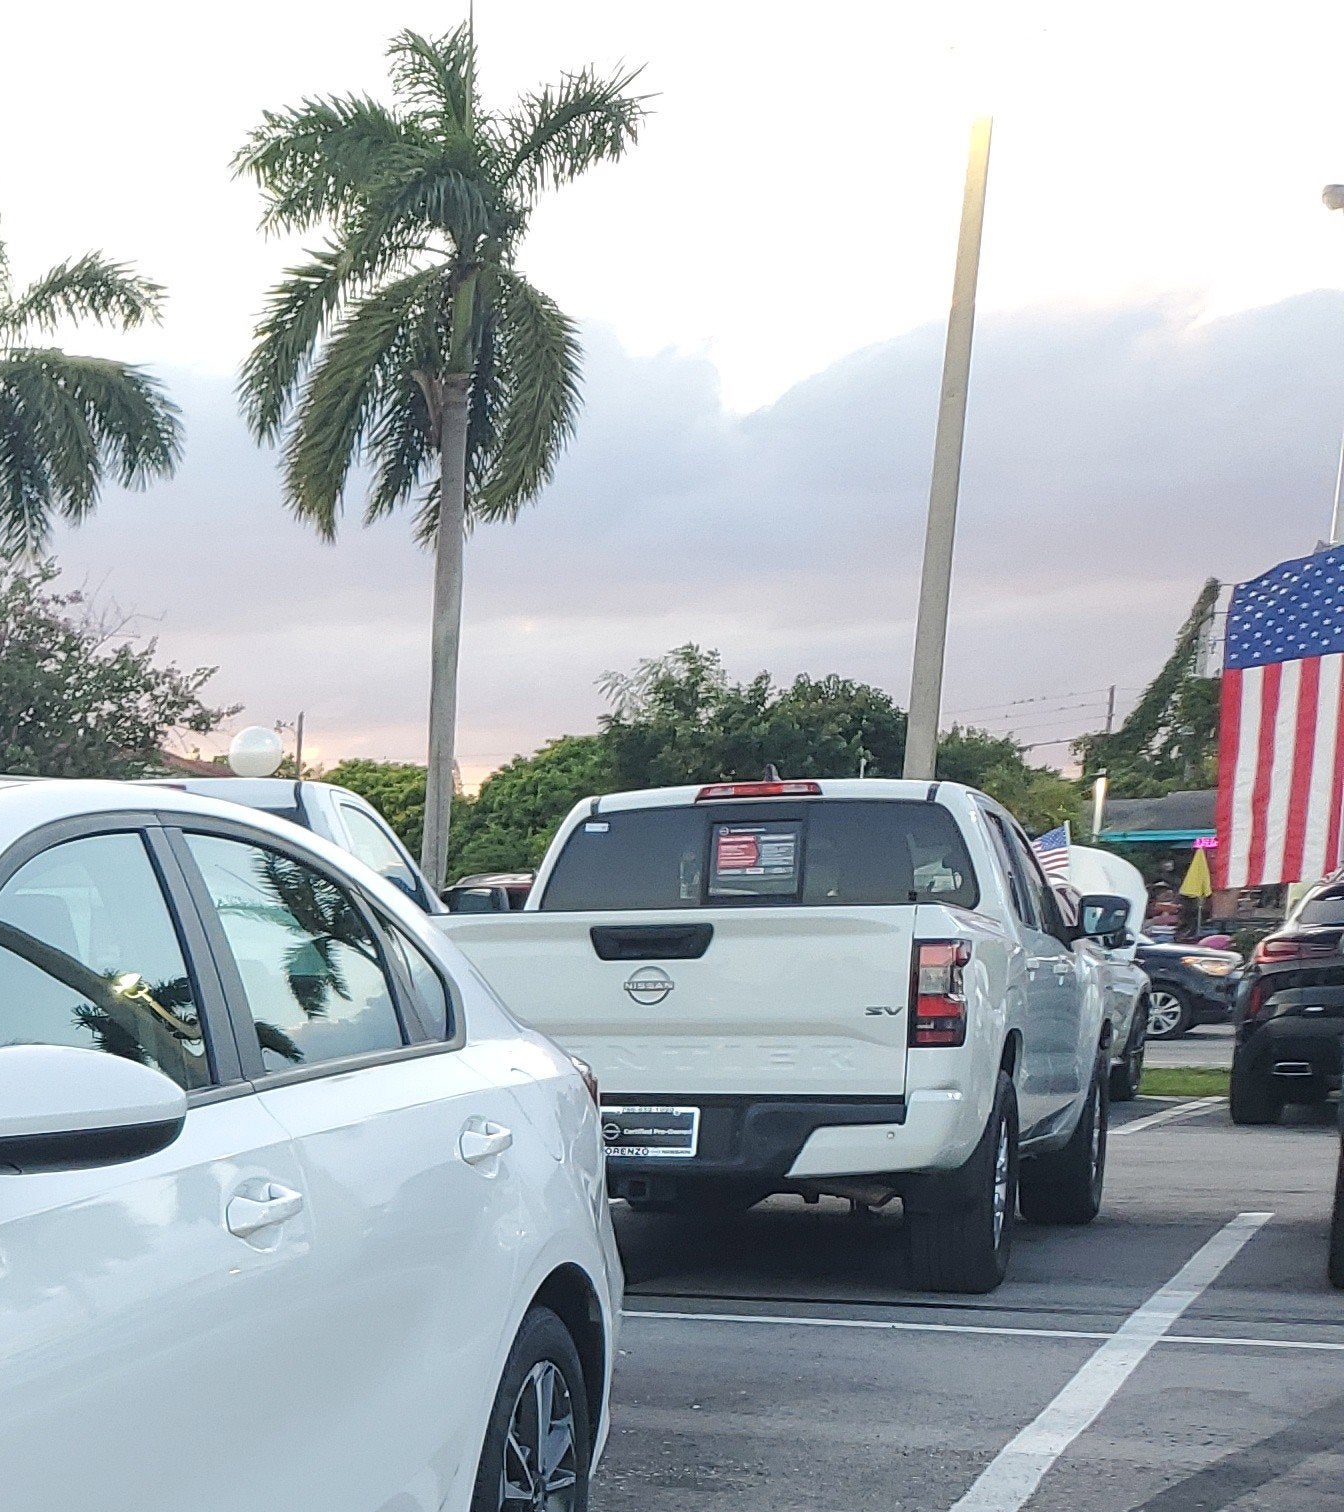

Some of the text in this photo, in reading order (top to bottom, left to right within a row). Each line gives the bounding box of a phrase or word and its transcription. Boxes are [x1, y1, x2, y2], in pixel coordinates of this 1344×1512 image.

[625, 982, 673, 990] NISSAN
[865, 1006, 904, 1015] SV
[604, 1147, 650, 1155] ORENZO
